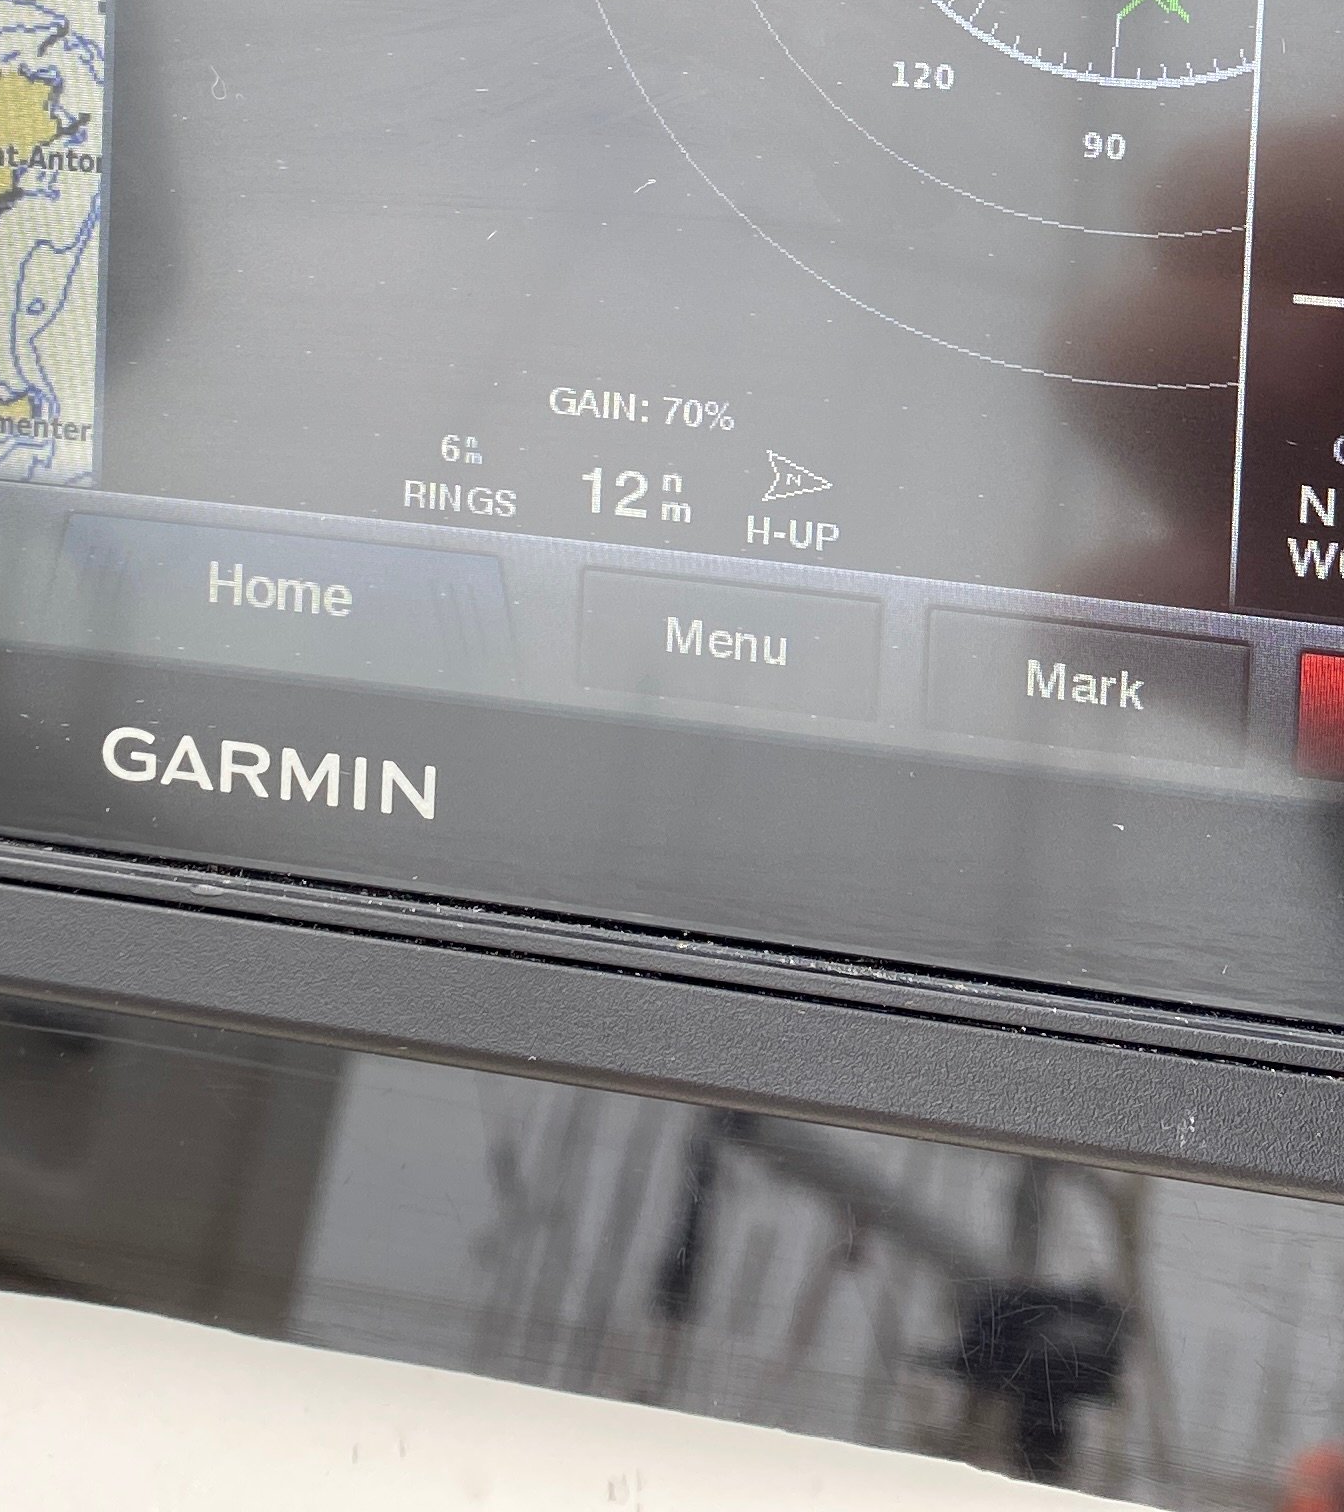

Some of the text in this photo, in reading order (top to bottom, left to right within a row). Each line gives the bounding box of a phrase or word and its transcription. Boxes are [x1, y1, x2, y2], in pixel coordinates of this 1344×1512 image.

[891, 60, 955, 90] 120
[1082, 131, 1127, 161] 90
[548, 386, 736, 432] GAIN: 70%
[402, 479, 517, 518] RINGS
[580, 466, 649, 519] 12
[1298, 484, 1337, 528] N
[745, 514, 841, 552] H-UP
[208, 559, 354, 618] Home
[664, 615, 789, 667] Menu
[1026, 659, 1145, 710] Mark
[101, 725, 437, 821] GARMIN
